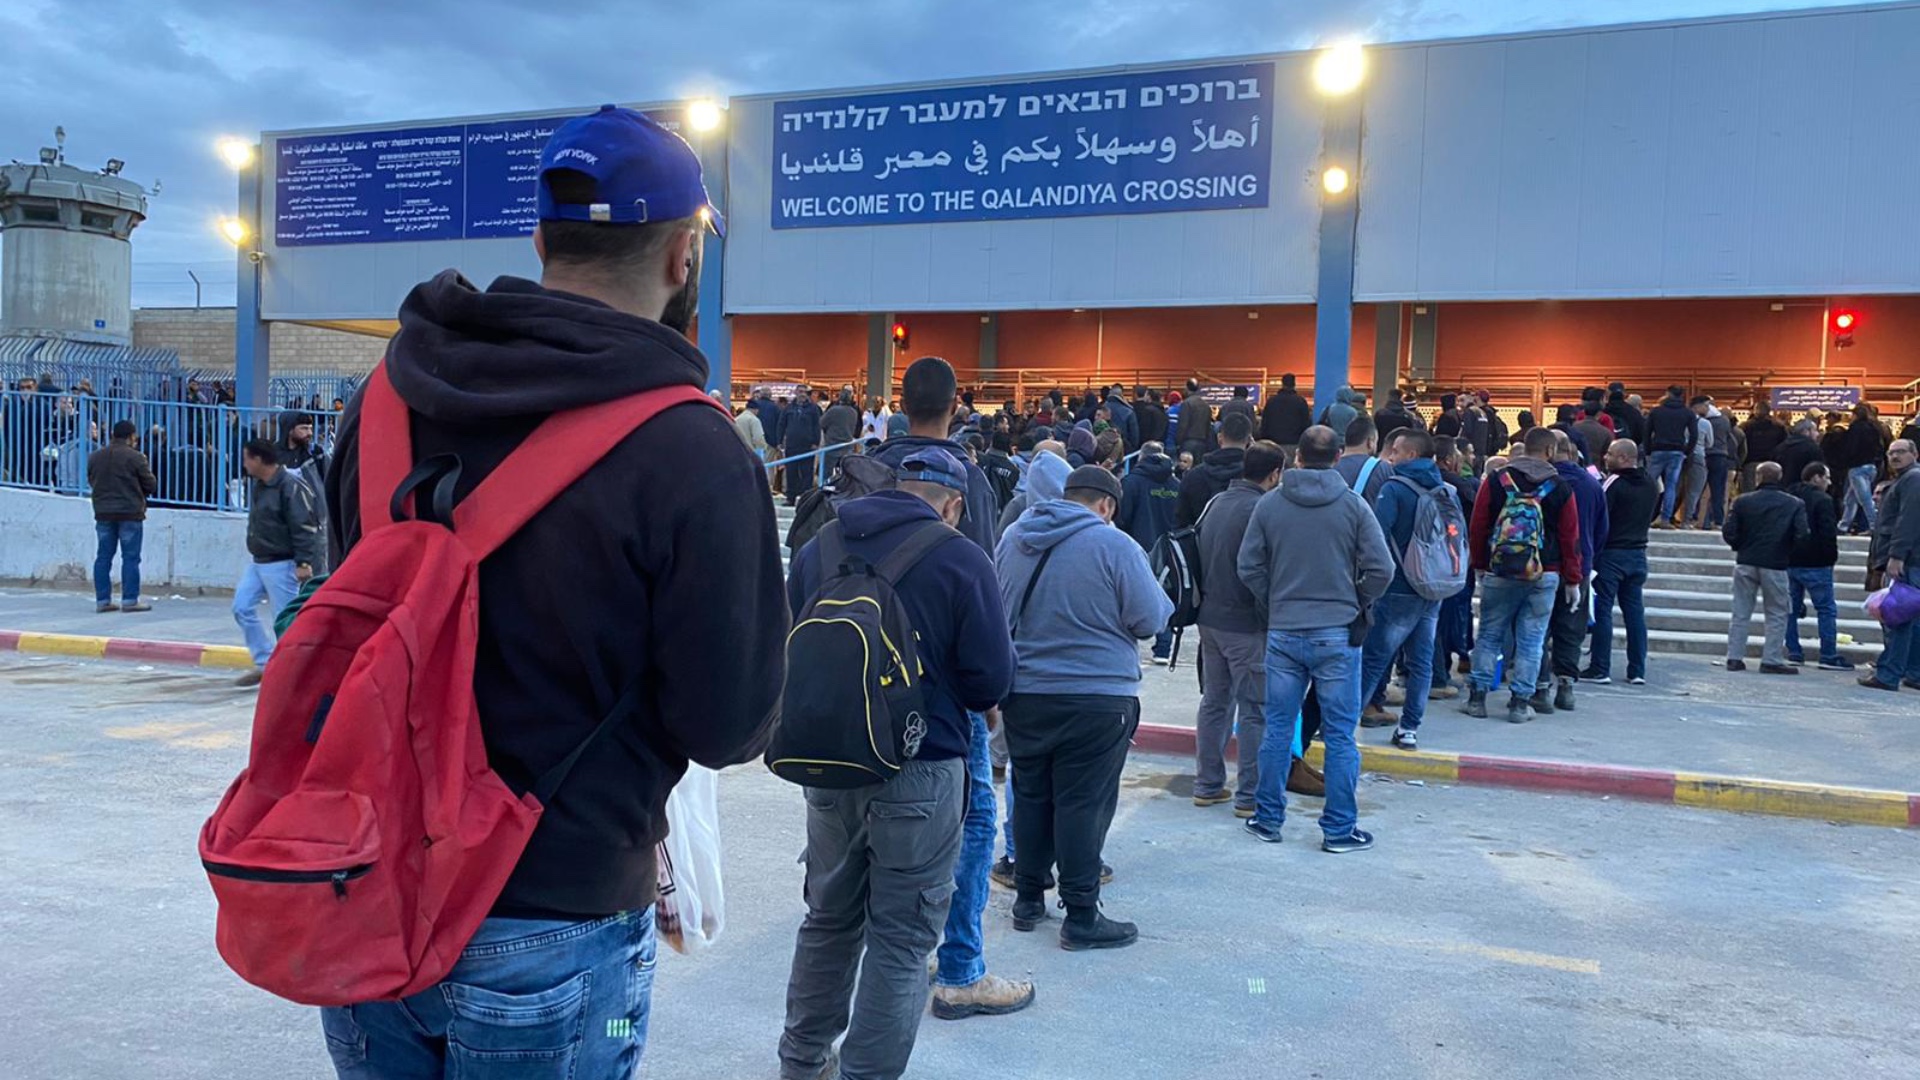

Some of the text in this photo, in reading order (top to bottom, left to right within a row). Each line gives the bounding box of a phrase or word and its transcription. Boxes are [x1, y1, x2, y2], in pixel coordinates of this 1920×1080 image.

[782, 78, 1261, 132] ברוכים הבאים למעבר קלנדיה
[781, 115, 1261, 181] أهلاً وسهلاً بكم في معبر قلنديا
[781, 174, 1258, 217] WELCOME TO THE QALANDIYA CROSSING
